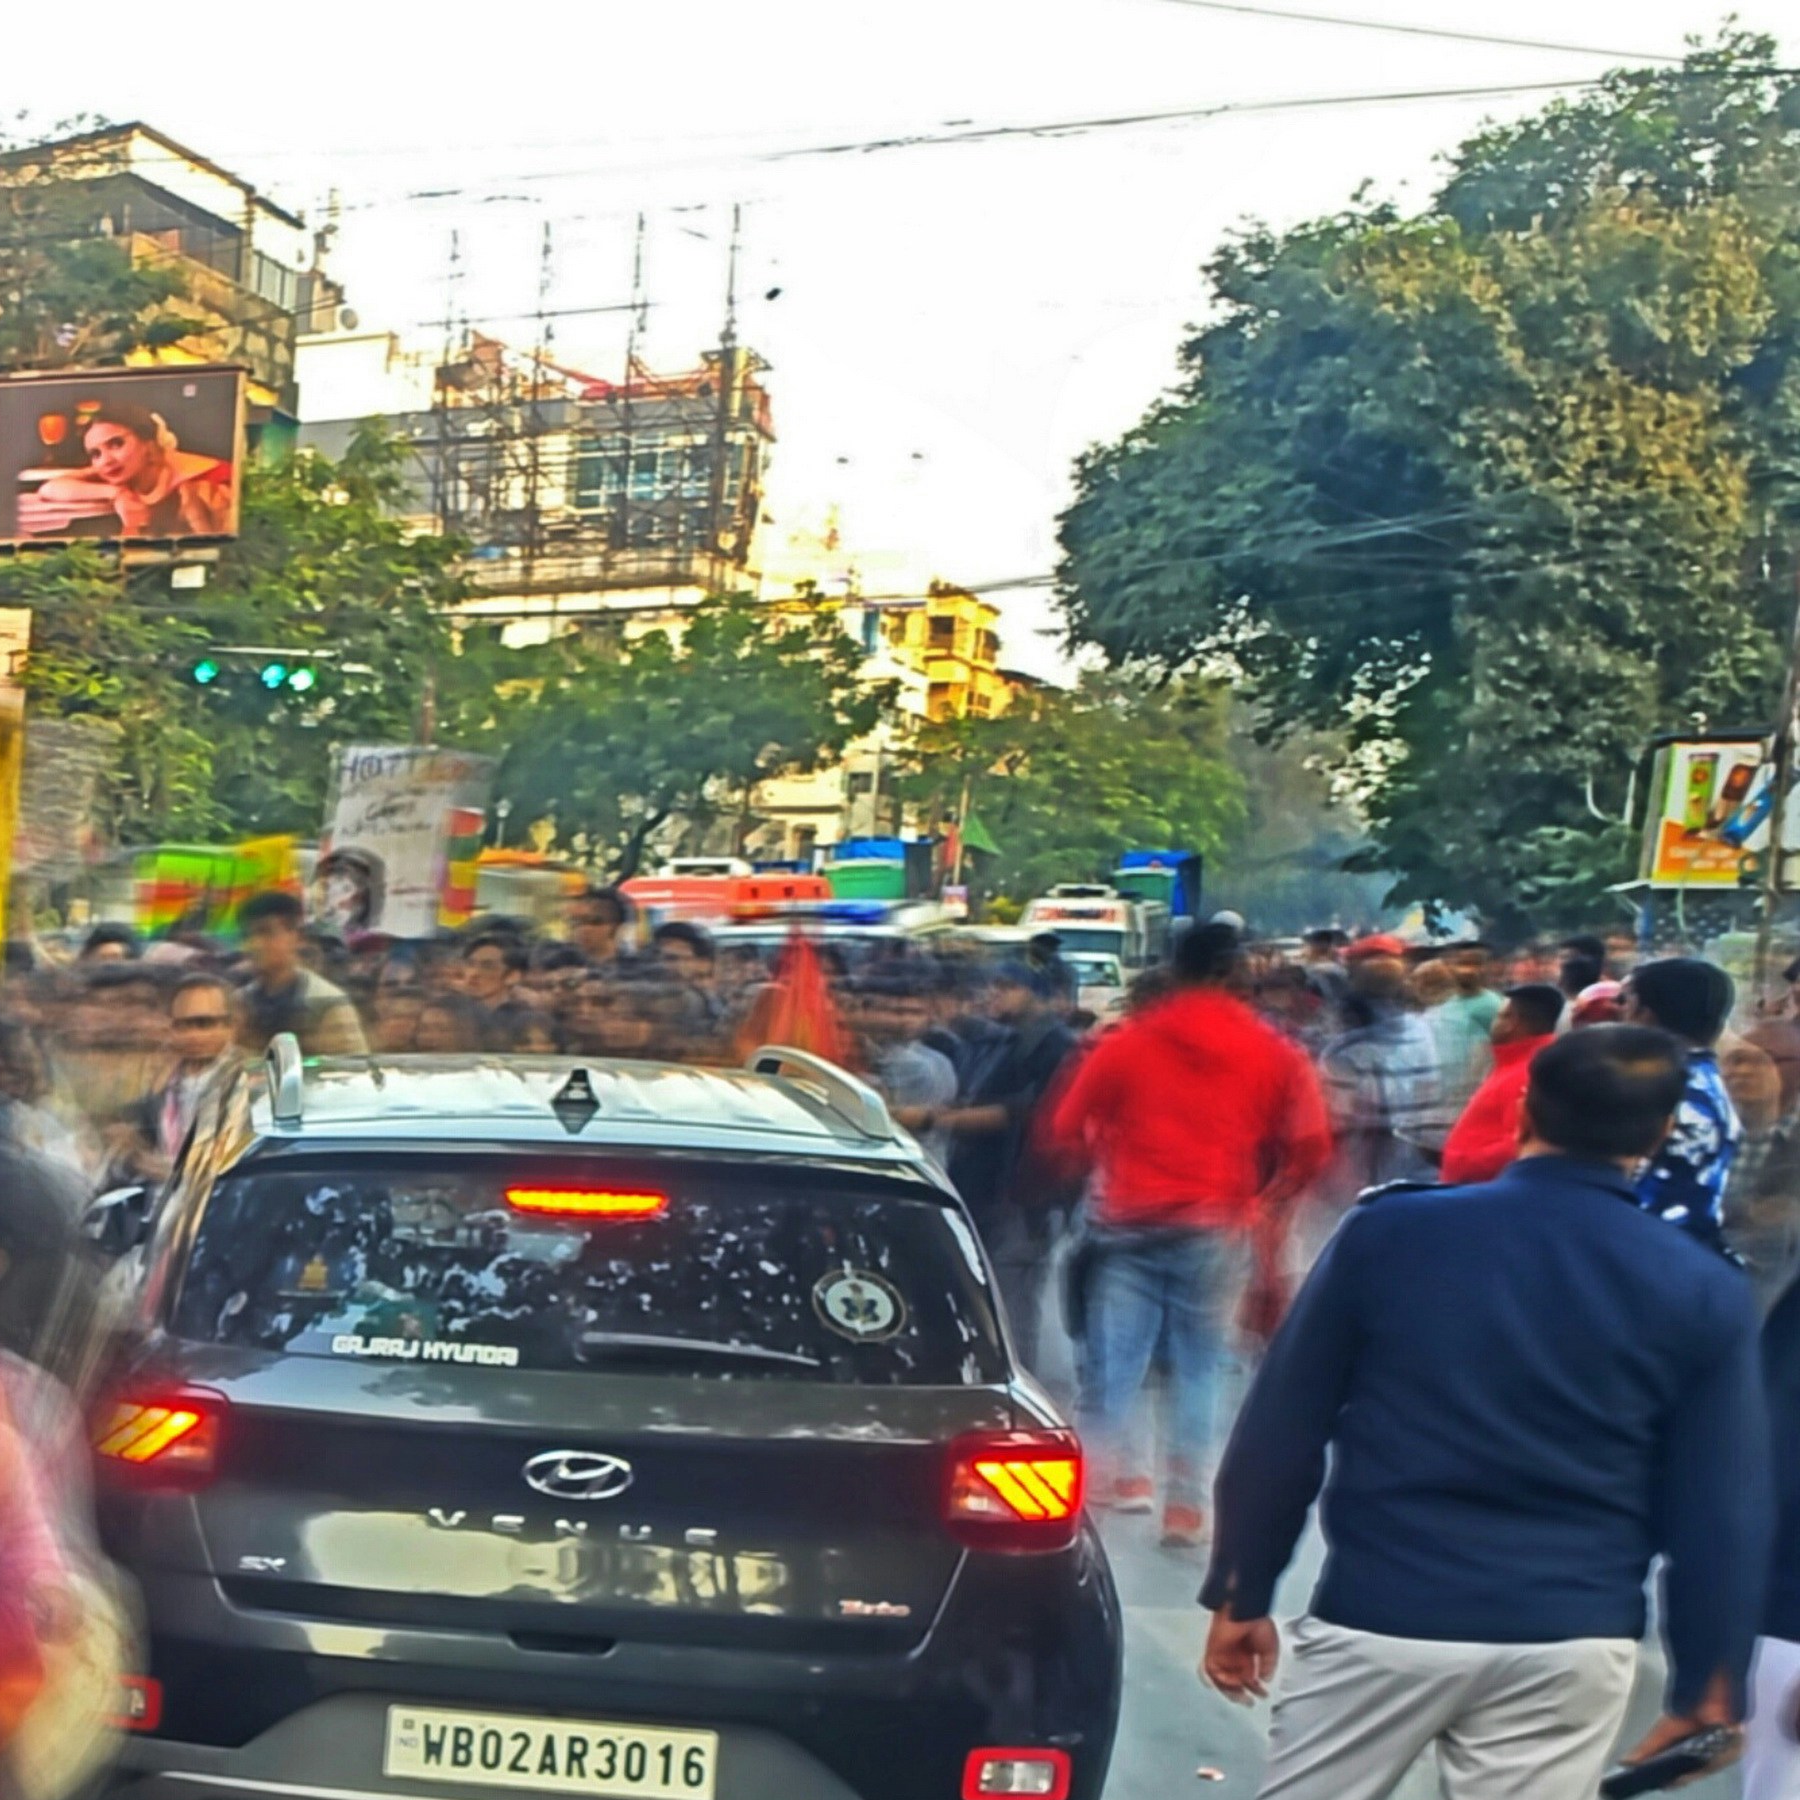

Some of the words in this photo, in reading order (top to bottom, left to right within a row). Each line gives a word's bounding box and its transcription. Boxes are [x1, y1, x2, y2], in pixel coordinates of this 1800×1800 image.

[332, 1335, 418, 1358] GAJRAJ
[422, 1341, 519, 1366] HYUNDAI
[428, 1507, 718, 1546] VENUE
[422, 1722, 705, 1788] WB02AR3016
